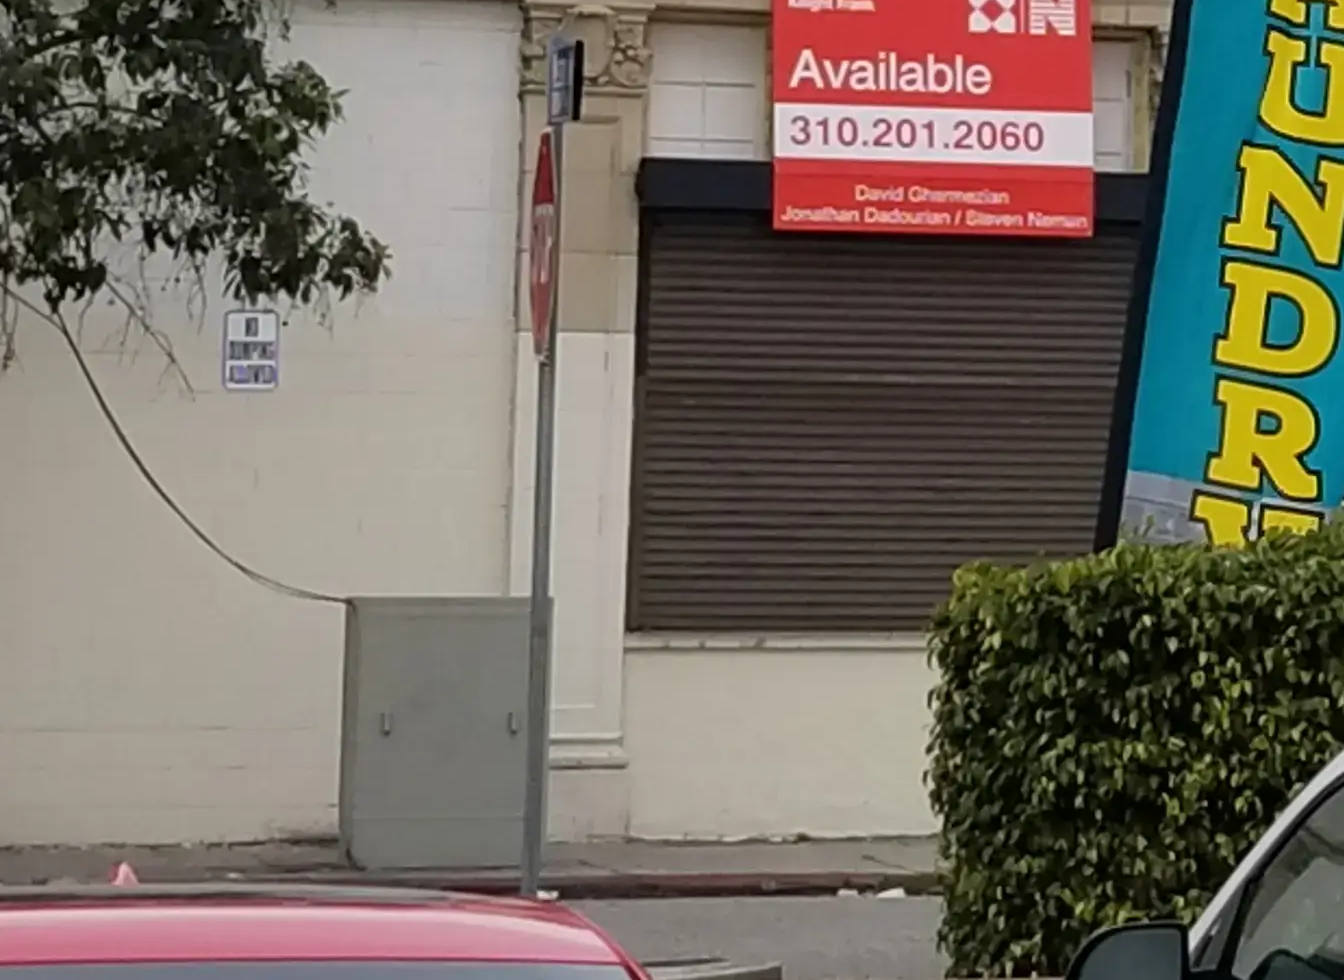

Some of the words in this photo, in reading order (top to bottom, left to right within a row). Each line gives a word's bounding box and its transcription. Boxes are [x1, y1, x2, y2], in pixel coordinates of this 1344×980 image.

[789, 48, 992, 95] Available
[790, 116, 1044, 152] 310.201.2060
[855, 184, 904, 202] David
[781, 206, 860, 225] Jonathan
